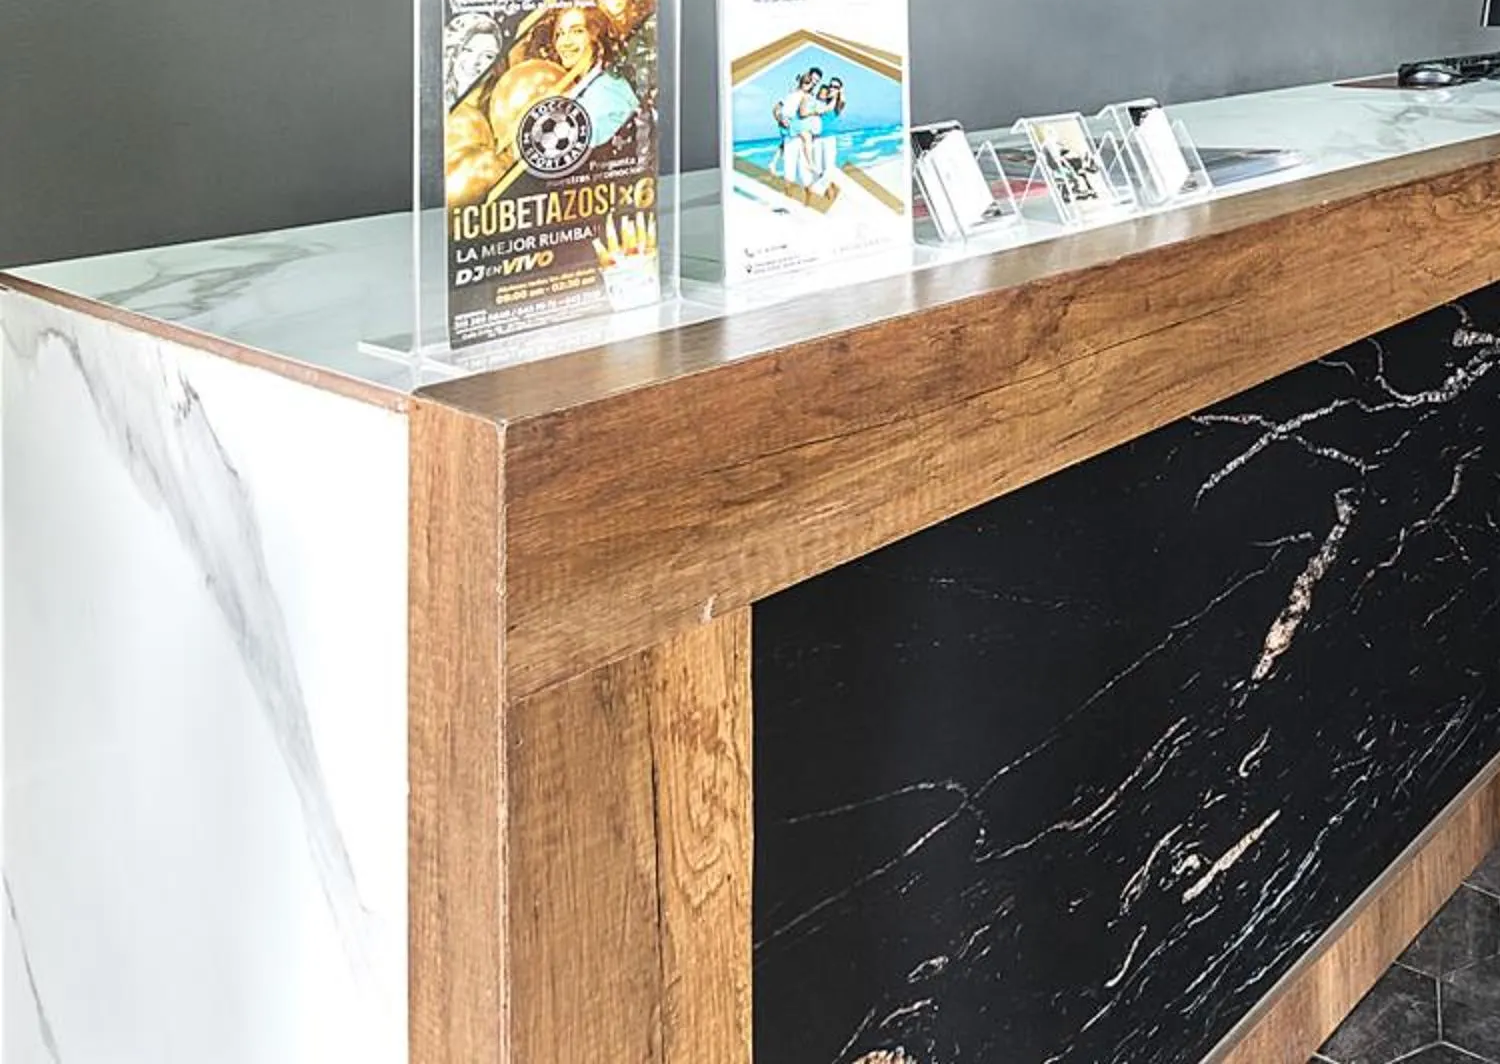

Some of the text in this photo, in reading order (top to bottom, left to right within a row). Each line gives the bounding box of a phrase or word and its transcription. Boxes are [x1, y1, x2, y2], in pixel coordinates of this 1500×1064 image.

[456, 248, 479, 263] LA
[481, 236, 537, 259] MEJOR
[455, 265, 485, 286] DJ
[502, 249, 555, 277] VIVO
